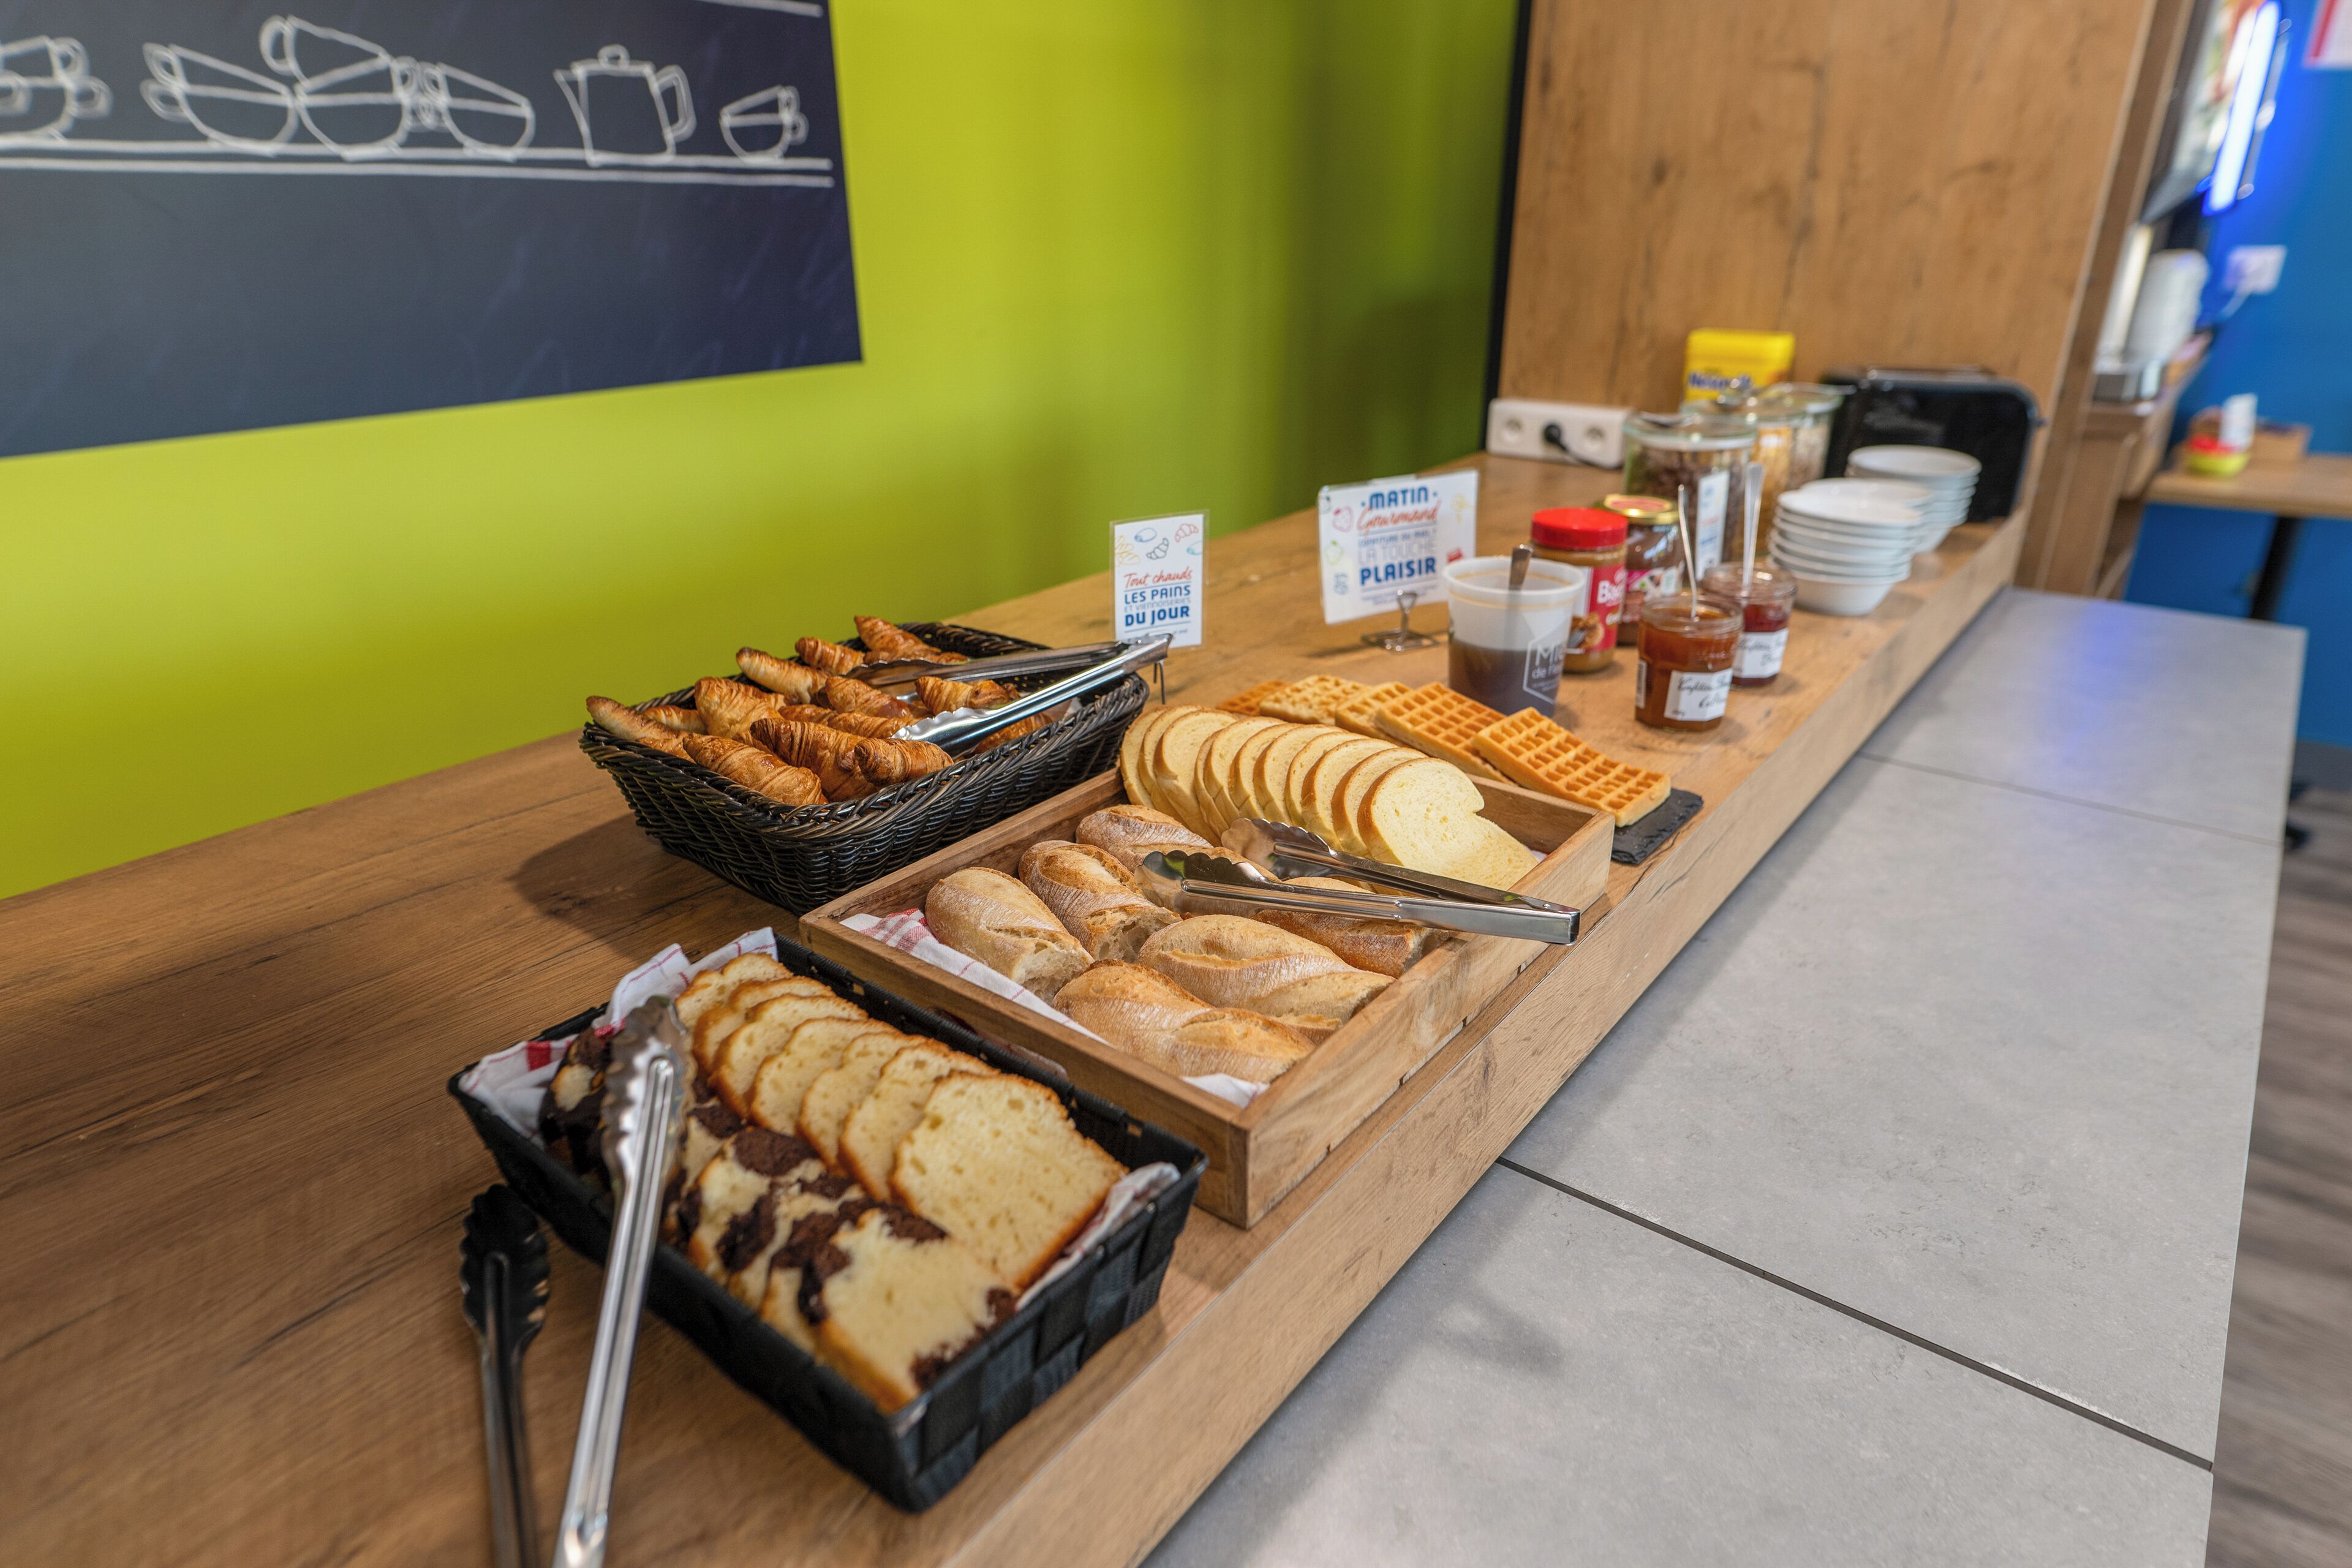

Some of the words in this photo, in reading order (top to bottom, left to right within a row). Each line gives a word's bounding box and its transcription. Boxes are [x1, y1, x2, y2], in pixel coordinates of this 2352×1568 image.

[1369, 486, 1428, 510] MATIN
[1124, 573, 1150, 588] Tout
[1152, 566, 1192, 583] chauds
[1360, 556, 1436, 586] PLAISIR
[1125, 590, 1147, 605] LES
[1151, 584, 1191, 600] PAINS
[1125, 612, 1145, 627] DU
[1151, 605, 1190, 625] JOUR
